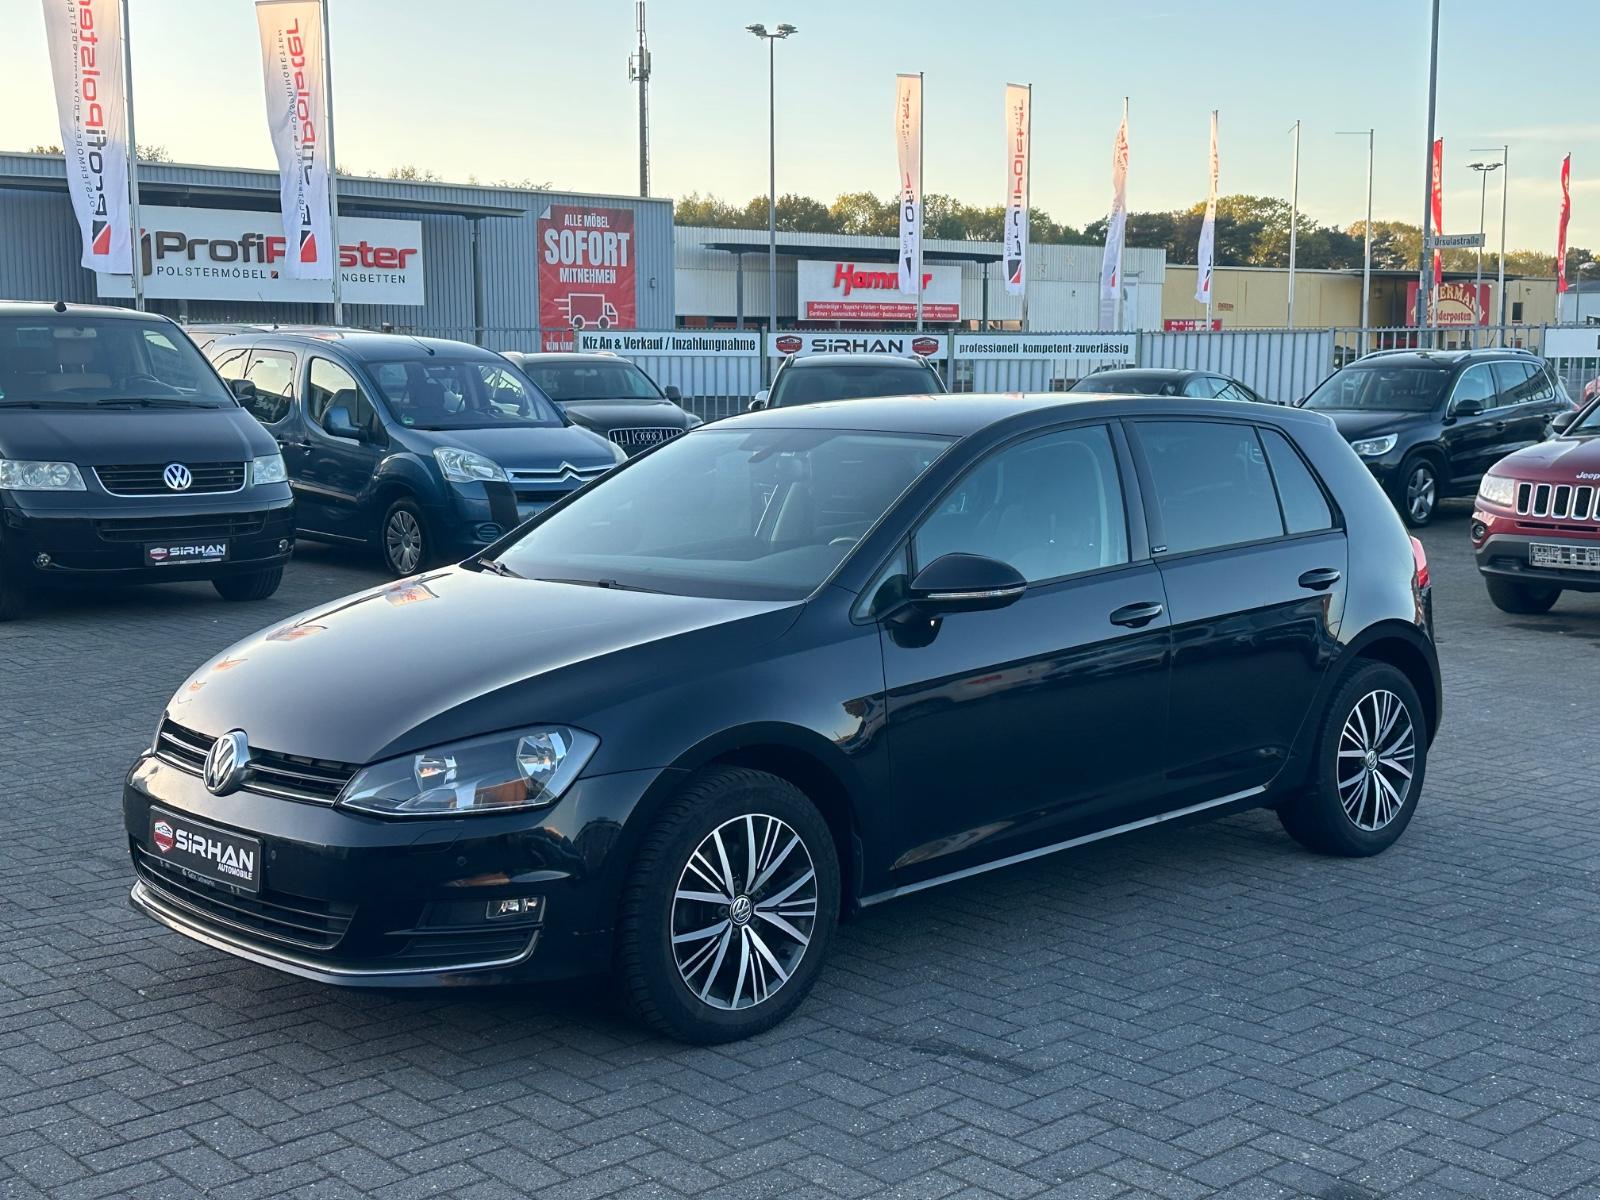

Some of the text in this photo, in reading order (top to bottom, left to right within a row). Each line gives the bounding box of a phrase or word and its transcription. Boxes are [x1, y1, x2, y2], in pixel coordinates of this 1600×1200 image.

[564, 213, 610, 228] ALLE MÖBEL
[544, 228, 630, 267] SOFORT
[1434, 235, 1480, 246] Ursulastraße
[156, 266, 267, 279] POLSTERMÖBEL
[560, 267, 616, 284] MITNEHMEN
[833, 263, 933, 297] Hammr
[582, 336, 598, 350] Kfz
[600, 336, 612, 350] An
[614, 338, 622, 350] &
[624, 336, 663, 350] Verkauf
[672, 337, 756, 351] Inzahlungnahme
[959, 342, 1129, 354] professionell kompetent zuverlässig
[1576, 471, 1600, 480] Jeep
[175, 828, 254, 872] SiRHAN
[217, 862, 253, 880] AUTOMOBILE
